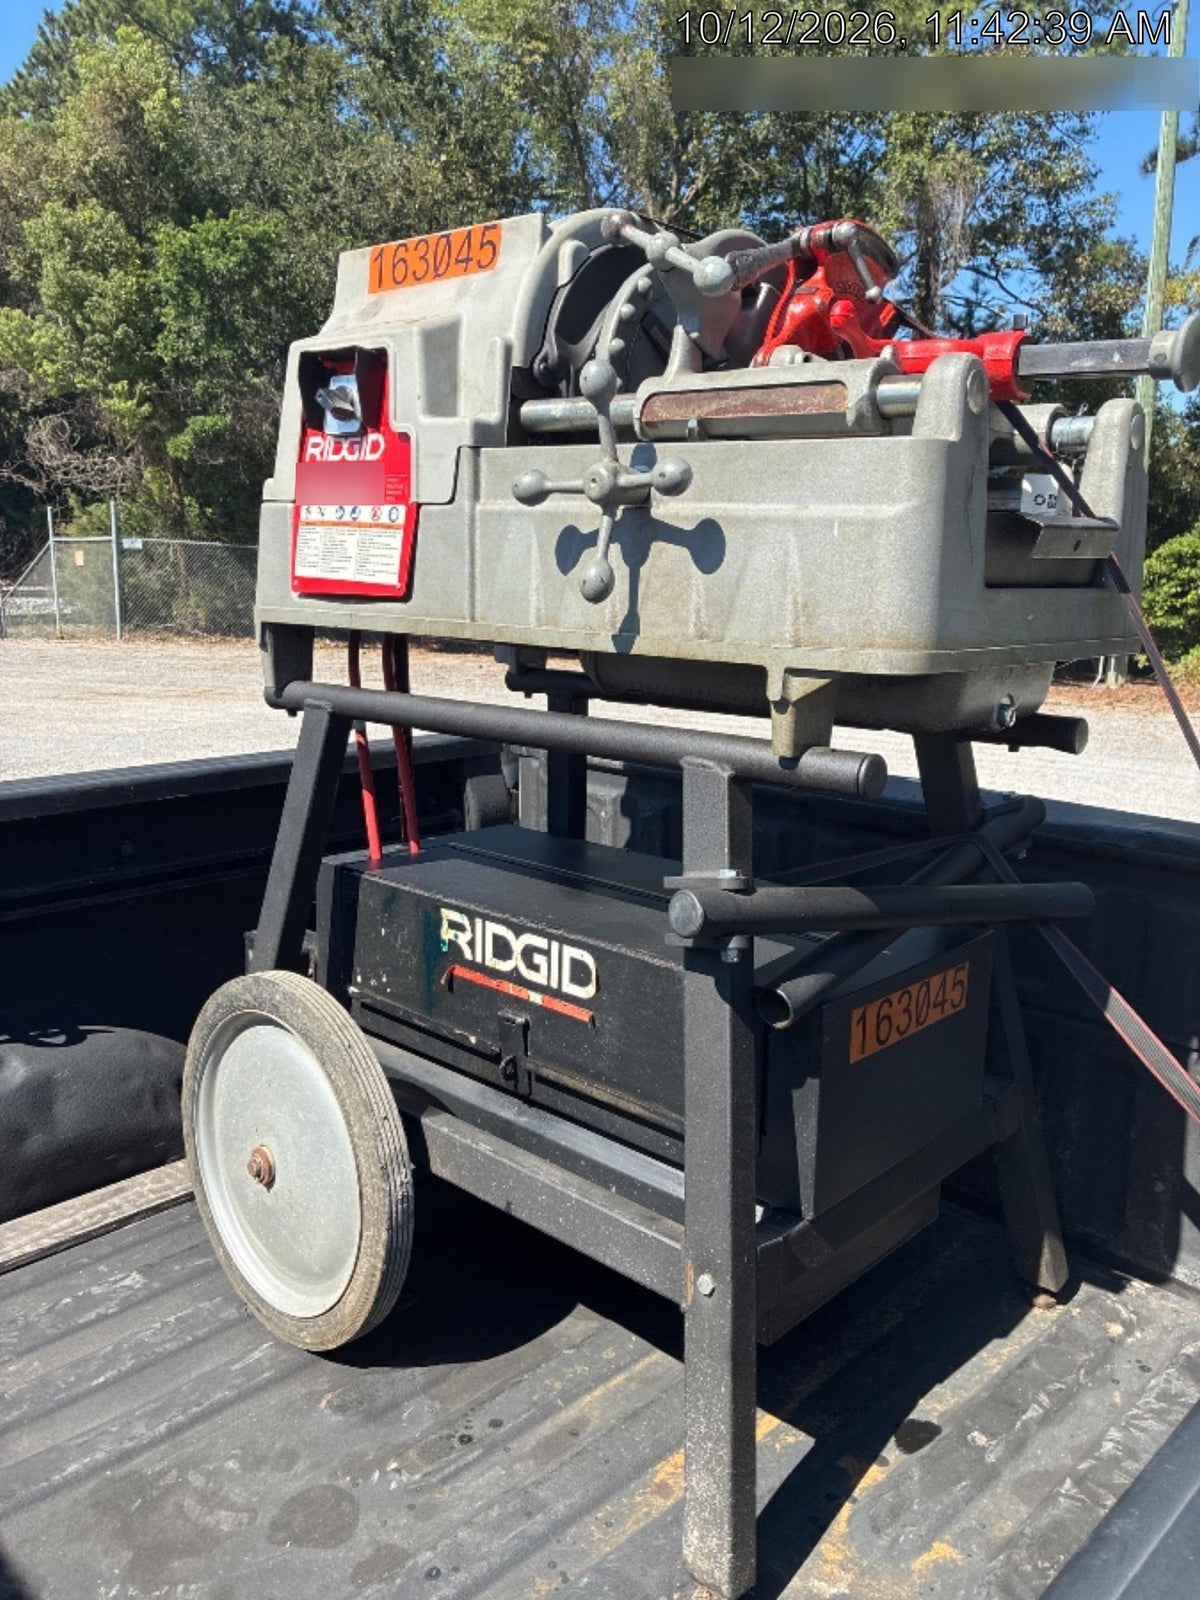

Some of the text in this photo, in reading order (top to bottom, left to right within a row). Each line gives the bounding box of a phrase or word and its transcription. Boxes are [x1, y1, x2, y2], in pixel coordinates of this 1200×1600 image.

[373, 223, 498, 288] 163045
[305, 433, 385, 462] RIDGID
[440, 907, 597, 999] RIDGID
[857, 964, 966, 1055] 163045
